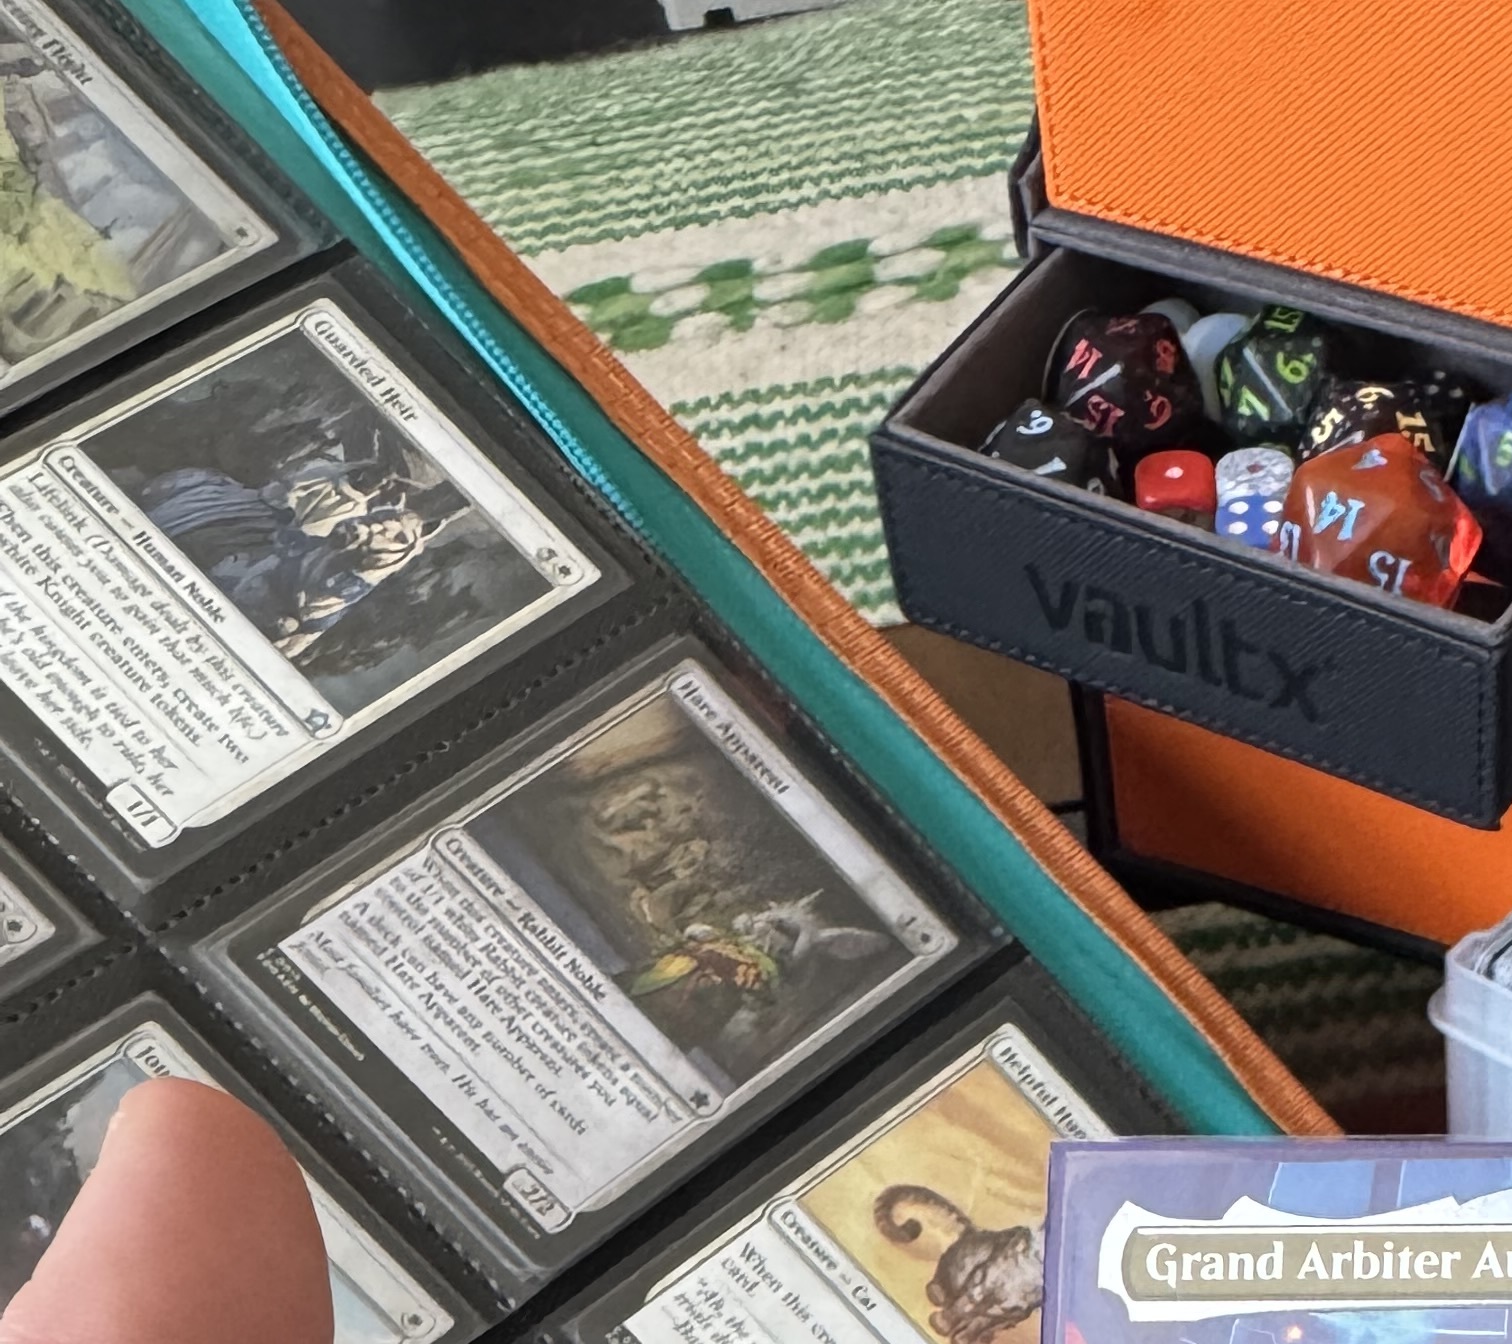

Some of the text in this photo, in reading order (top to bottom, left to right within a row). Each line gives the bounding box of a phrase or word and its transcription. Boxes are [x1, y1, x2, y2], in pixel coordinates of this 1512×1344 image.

[123, 798, 159, 828] 1/1
[1146, 1241, 1283, 1288] Grand
[1297, 1240, 1461, 1279] Arbiter
